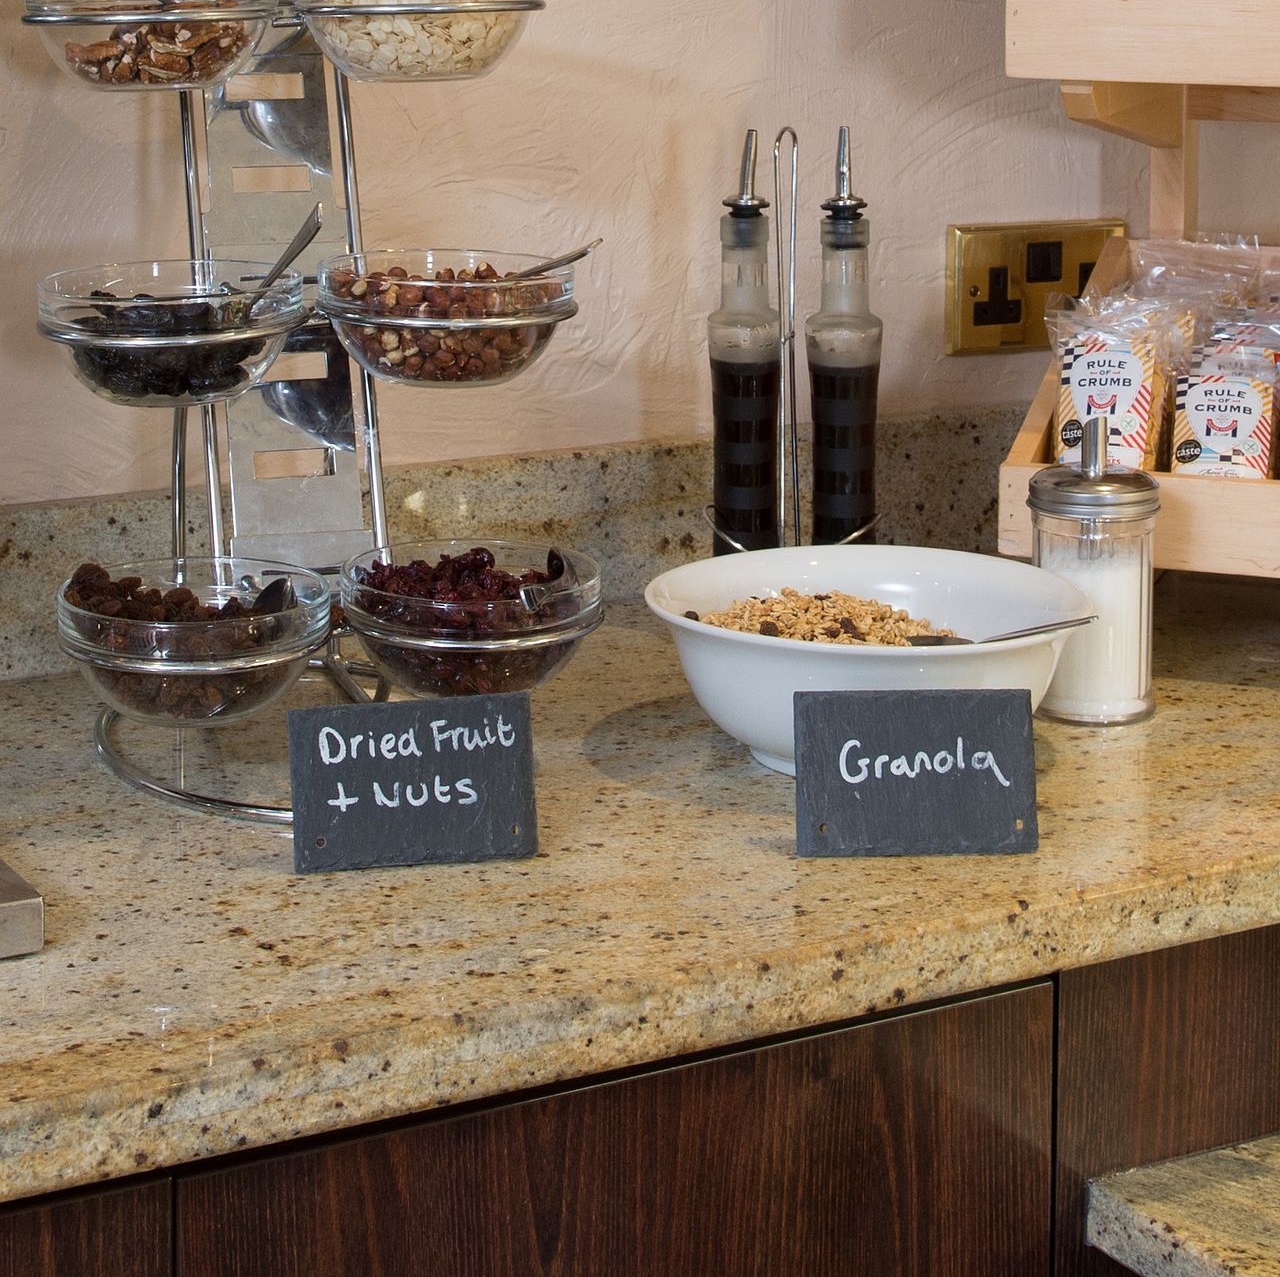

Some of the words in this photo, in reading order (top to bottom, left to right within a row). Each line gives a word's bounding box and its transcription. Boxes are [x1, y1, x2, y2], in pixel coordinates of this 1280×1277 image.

[1086, 360, 1127, 370] RULE
[1077, 377, 1133, 387] CRUMB
[1204, 389, 1247, 399] RULE
[1194, 404, 1253, 415] CRUMB
[1176, 447, 1202, 458] taste
[318, 725, 423, 765] Dried
[429, 714, 516, 752] Fruit
[839, 736, 1011, 787] Granola
[327, 782, 360, 812] +
[373, 775, 479, 807] Nuts
